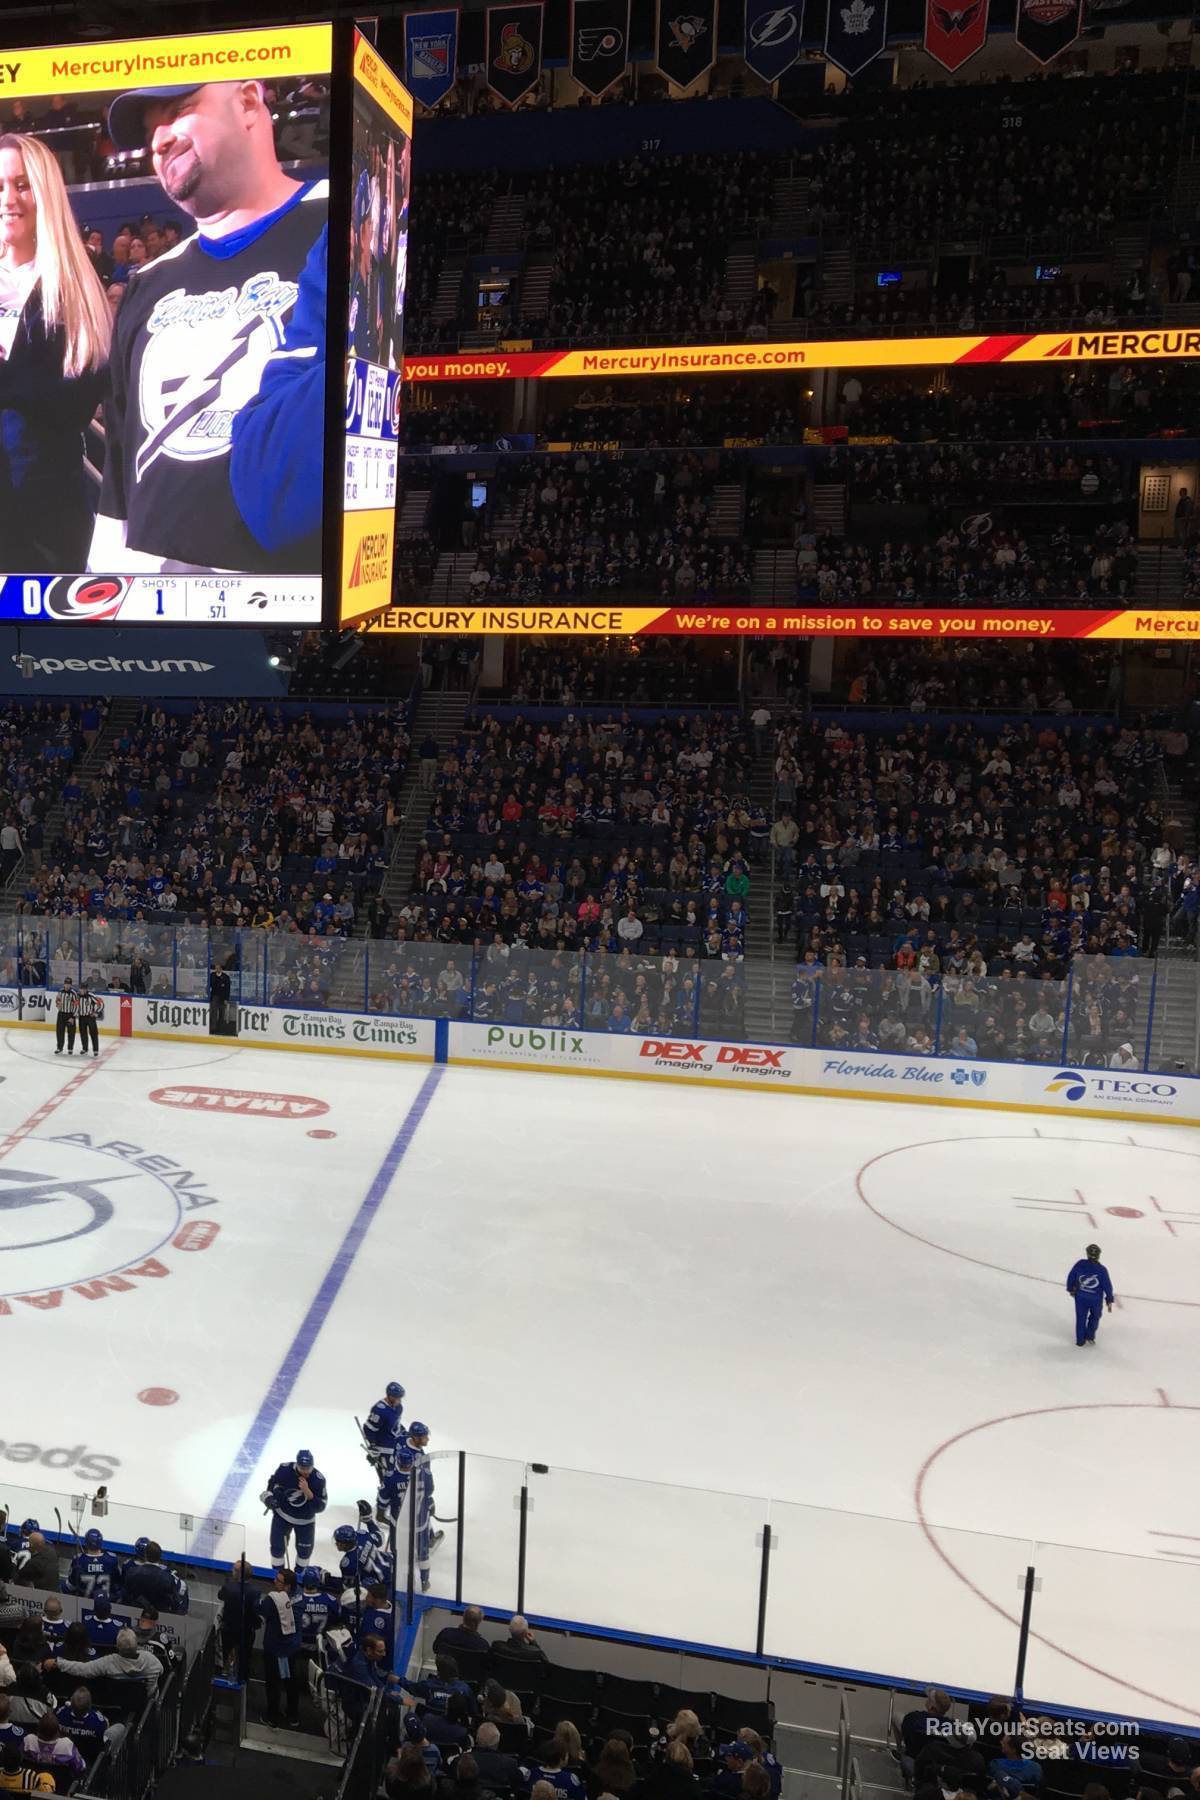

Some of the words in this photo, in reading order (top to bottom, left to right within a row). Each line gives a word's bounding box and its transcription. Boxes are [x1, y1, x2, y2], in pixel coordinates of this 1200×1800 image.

[52, 43, 292, 78] MercuryInsurance.com
[1002, 117, 1023, 128] 318
[405, 362, 440, 380] you
[444, 359, 511, 377] money.
[582, 350, 806, 371] MercuryInsurance.com
[142, 579, 177, 588] SHOTS
[194, 579, 242, 588] FACEOFF
[23, 579, 41, 615] 0
[155, 590, 165, 615] 1
[218, 591, 226, 603] 4
[481, 611, 623, 630] INSURANCE
[675, 613, 732, 629] We're
[736, 617, 760, 629] on
[765, 617, 777, 629] a
[783, 614, 857, 630] mission
[862, 616, 882, 630] to
[888, 618, 932, 631] save
[939, 618, 976, 635] you
[982, 618, 1056, 635] money.
[282, 1014, 347, 1039] Times
[303, 1013, 326, 1022] Tampa
[327, 1015, 343, 1025] Bay
[374, 1018, 398, 1028] Tampa
[399, 1022, 415, 1031] Bay
[352, 1020, 418, 1045] Times
[487, 1026, 585, 1053] Publix
[639, 1040, 710, 1061] DEX
[716, 1046, 787, 1068] DEX
[655, 1058, 713, 1072] imaging
[732, 1063, 792, 1079] imaging
[823, 1060, 897, 1080] Florida
[901, 1066, 945, 1083] Blue
[1090, 1077, 1177, 1097] TECO
[159, 1090, 320, 1116] AMALIE
[50, 1132, 220, 1212] ARENA
